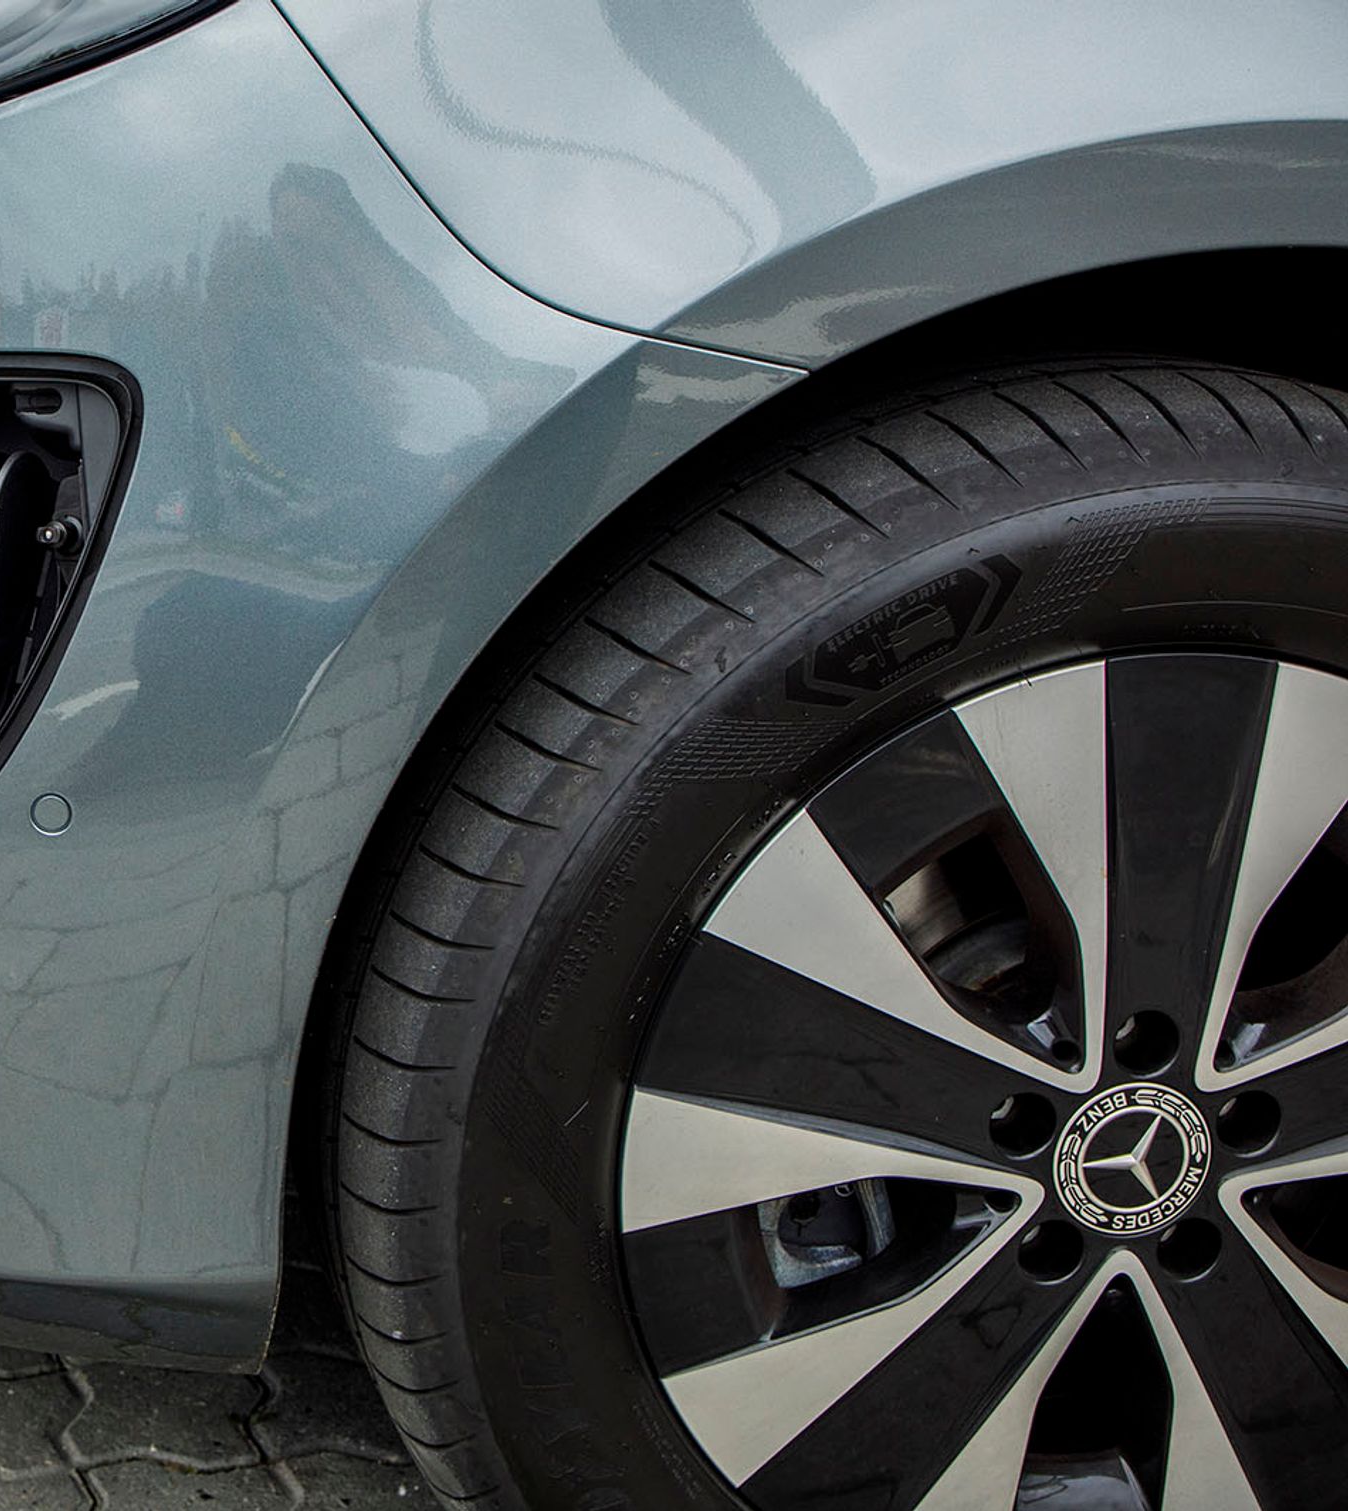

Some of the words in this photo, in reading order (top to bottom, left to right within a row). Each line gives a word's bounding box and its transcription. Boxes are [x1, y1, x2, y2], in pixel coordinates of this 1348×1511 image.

[826, 601, 901, 653] ELECTRIC
[906, 573, 958, 606] DRIVE
[1076, 1092, 1128, 1133] BENZ
[1112, 1166, 1203, 1230] MERCEDES
